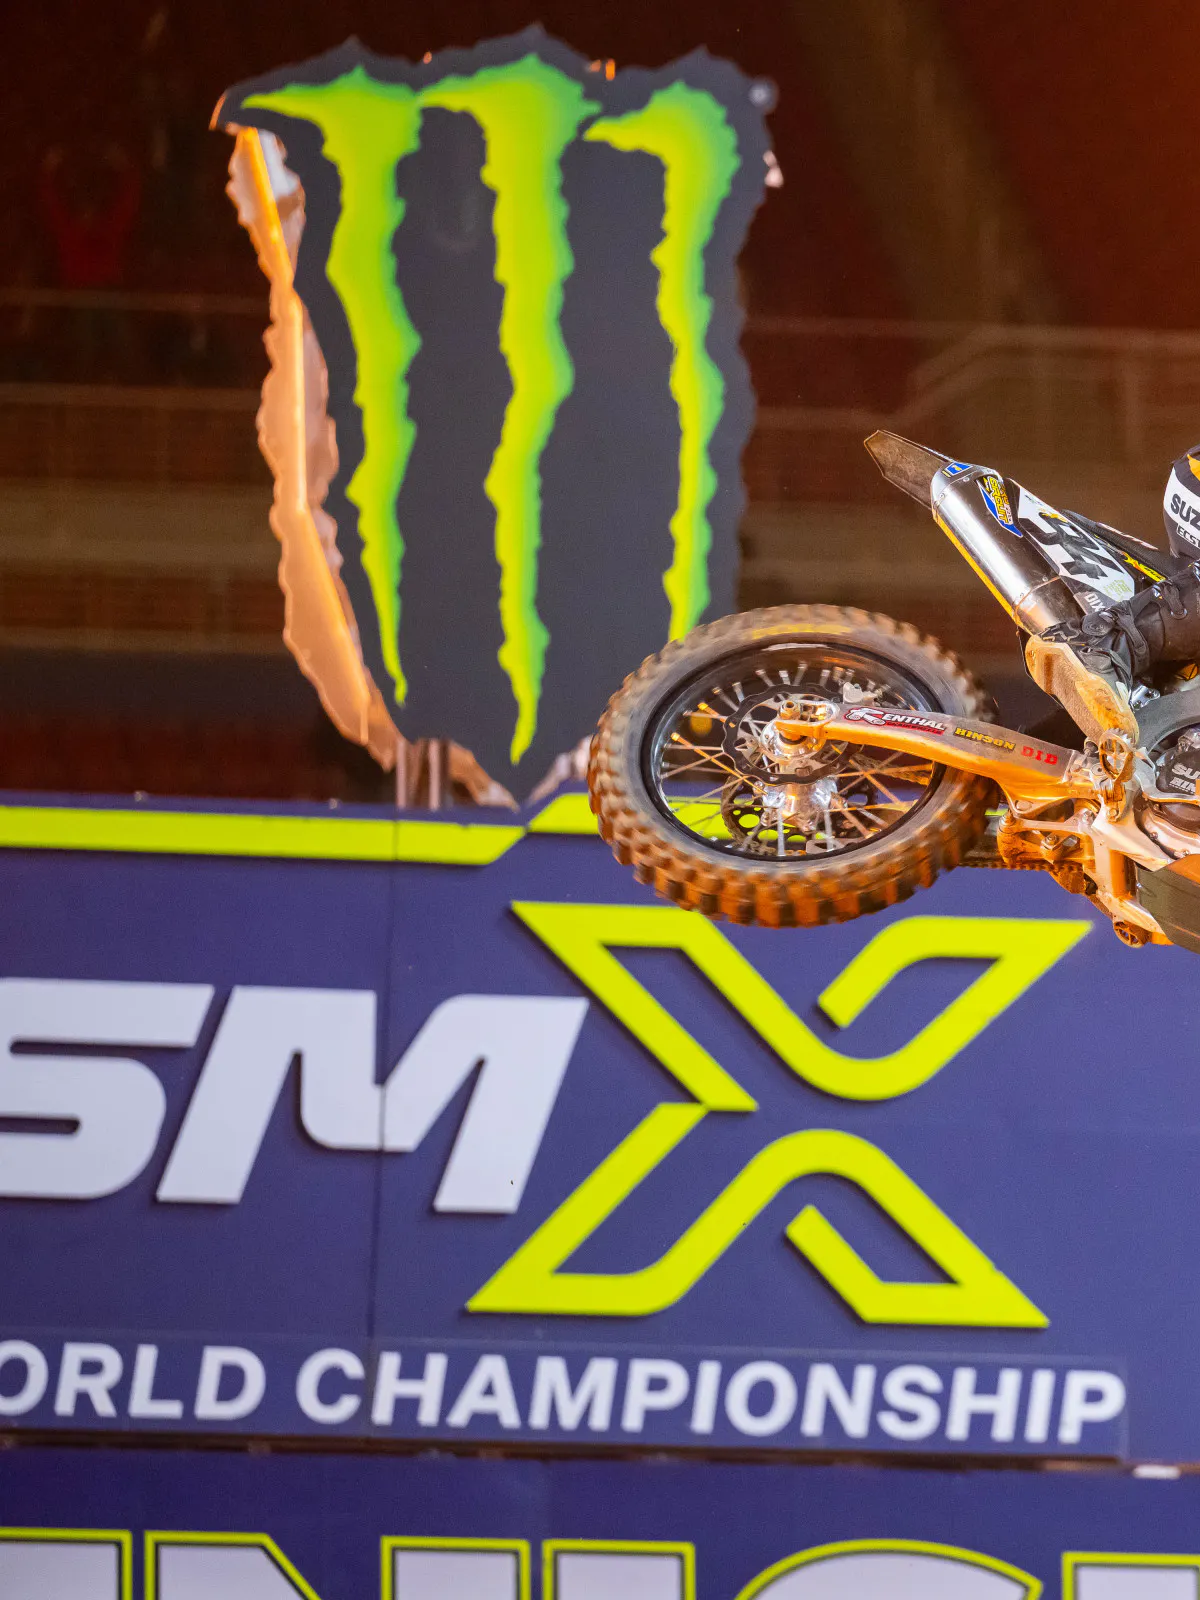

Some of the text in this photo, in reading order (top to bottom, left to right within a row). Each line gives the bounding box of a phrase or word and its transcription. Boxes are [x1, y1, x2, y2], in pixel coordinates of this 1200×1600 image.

[955, 727, 1016, 750] HINSON
[1020, 745, 1058, 765] DID
[295, 1347, 1127, 1445] CHAMPIONSHIP
